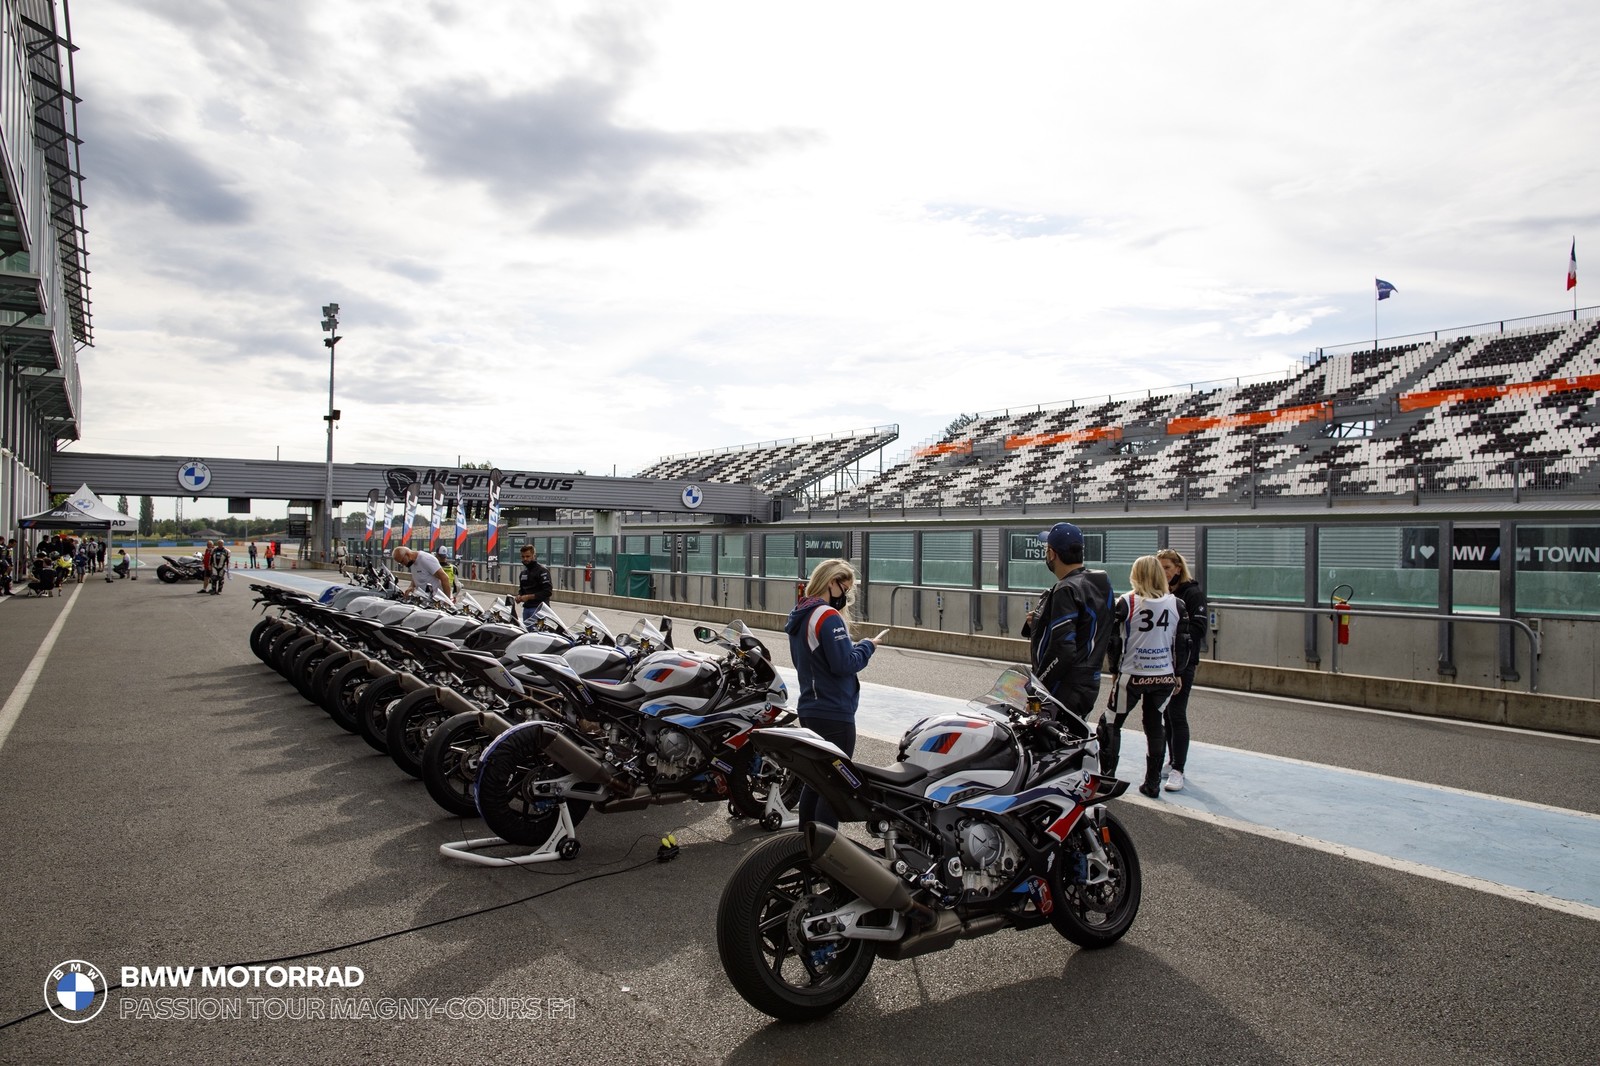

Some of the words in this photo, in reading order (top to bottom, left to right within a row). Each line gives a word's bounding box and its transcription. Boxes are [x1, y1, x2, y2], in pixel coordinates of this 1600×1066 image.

[1452, 545, 1486, 561] MW
[1534, 546, 1600, 563] TOWN
[1138, 609, 1170, 632] 34
